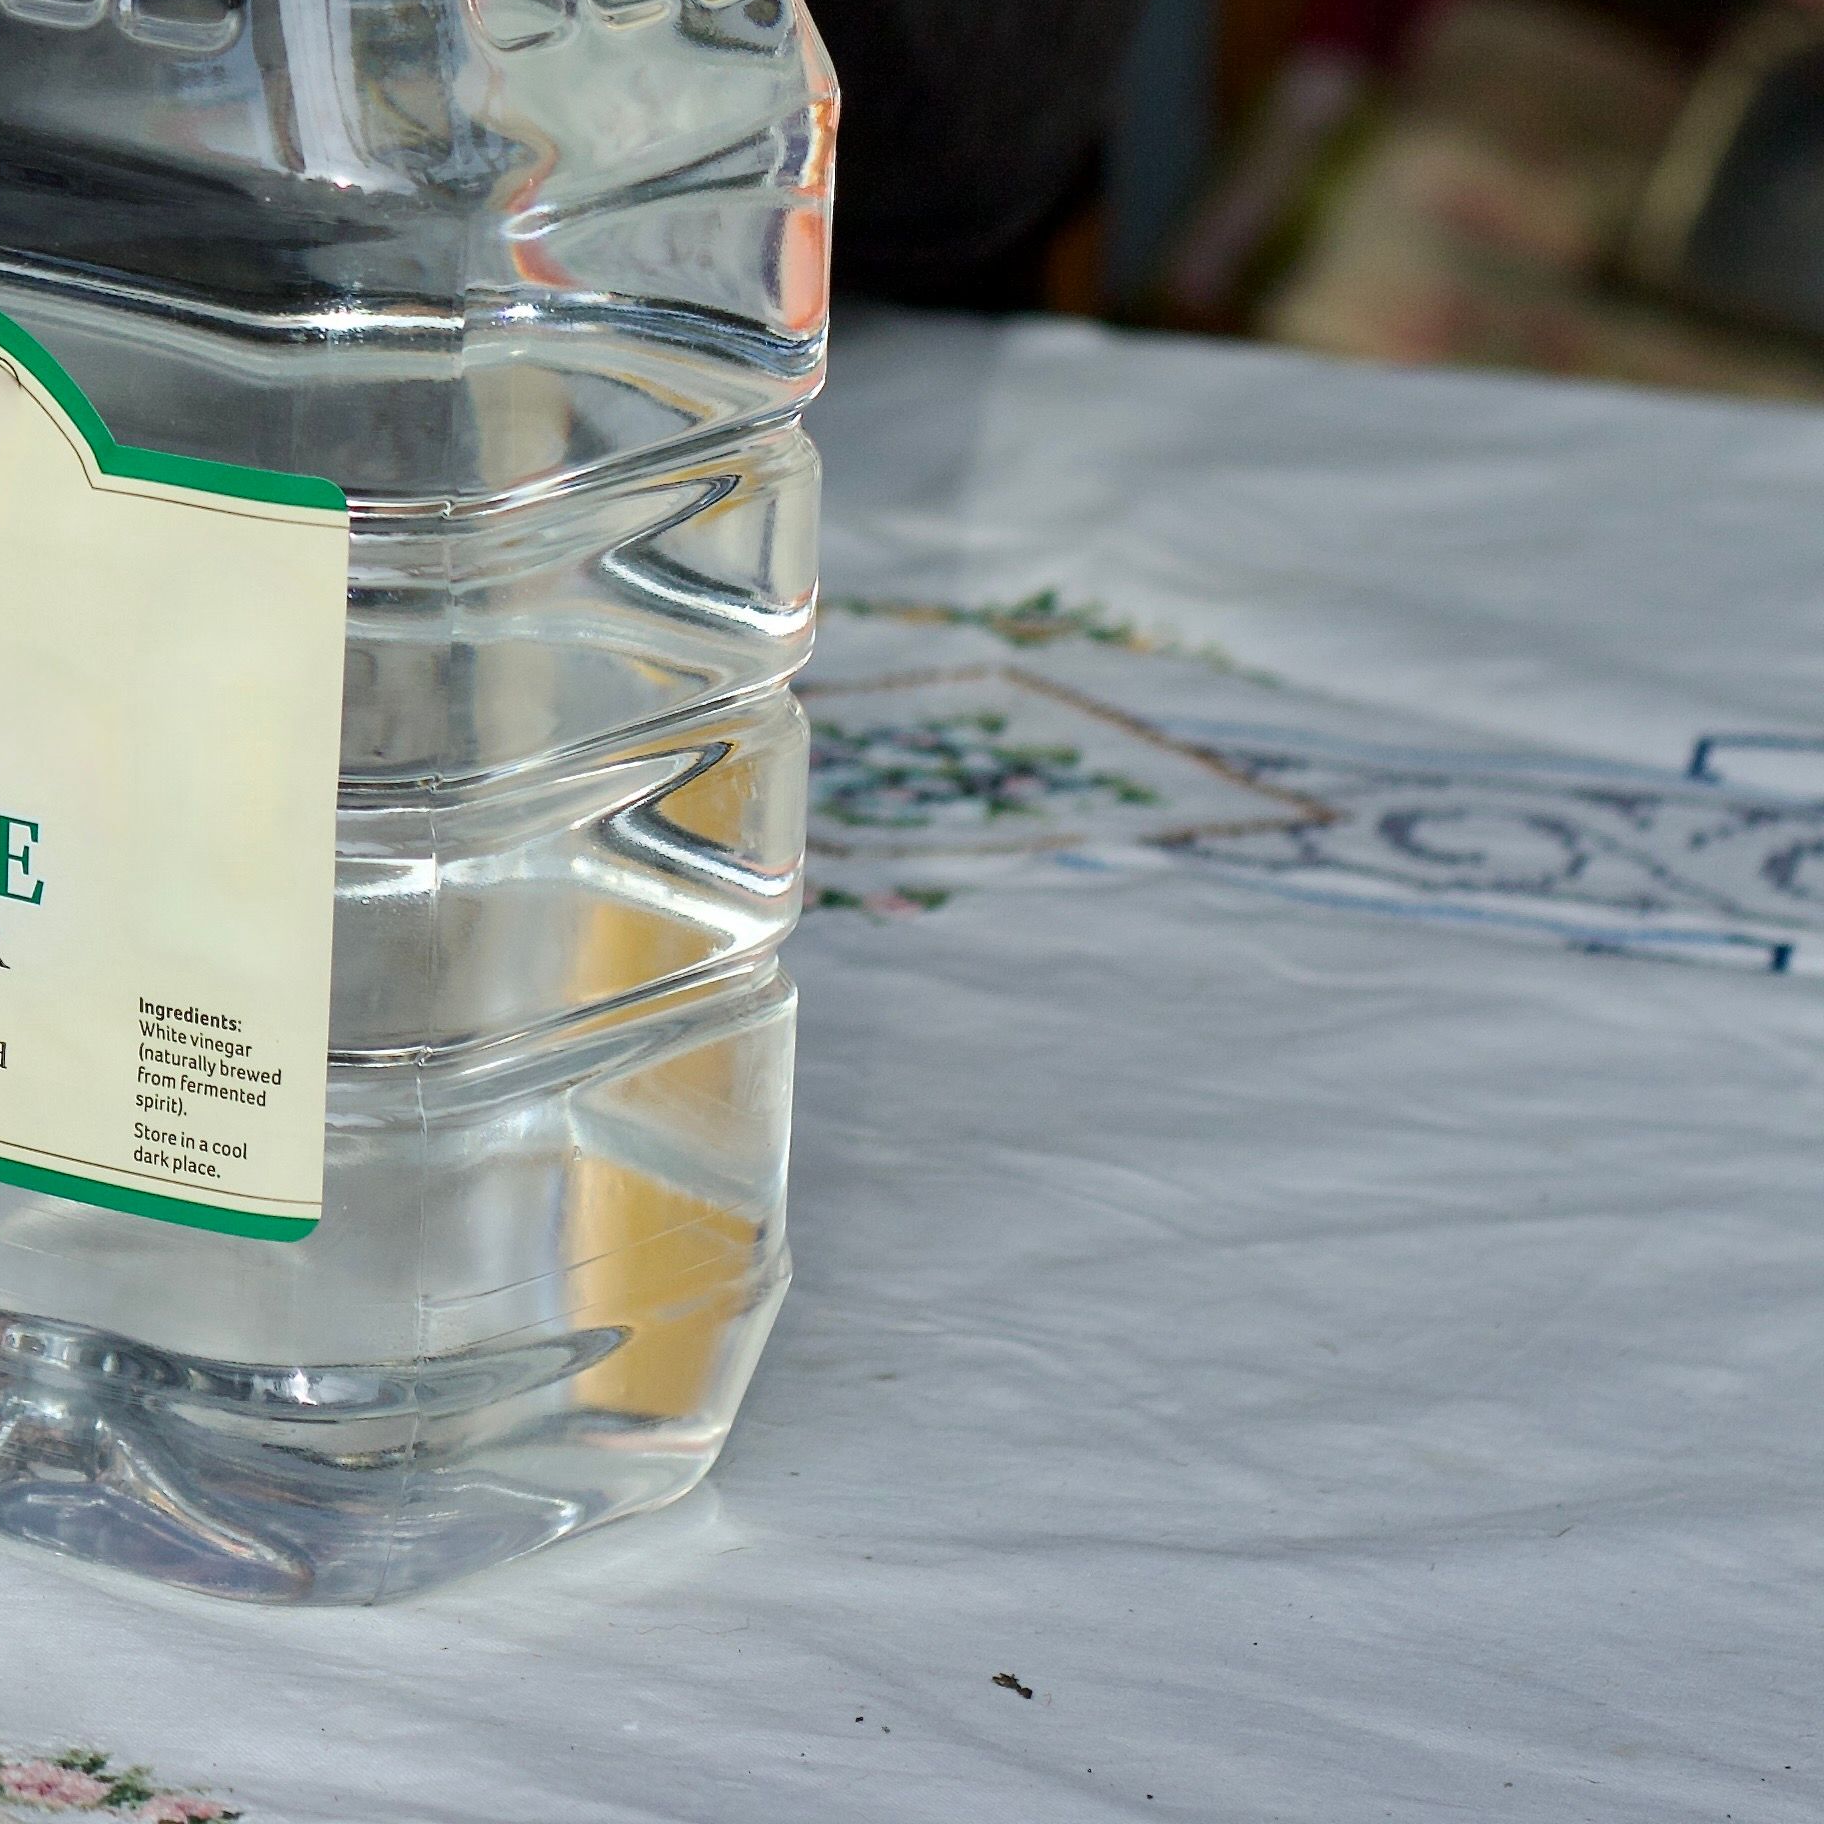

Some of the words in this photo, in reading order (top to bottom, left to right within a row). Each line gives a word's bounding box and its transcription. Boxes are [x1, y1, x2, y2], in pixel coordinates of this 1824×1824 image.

[139, 996, 242, 1033] Ingredients:
[139, 1020, 187, 1044] White
[190, 1032, 253, 1058] vinegar
[138, 1042, 216, 1077] (naturally
[220, 1059, 282, 1085] brewed
[136, 1093, 187, 1117] spirit).
[137, 1066, 176, 1089] from
[180, 1074, 266, 1107] fermented
[134, 1122, 177, 1146] Store
[181, 1131, 195, 1150] in
[199, 1140, 208, 1153] a
[212, 1142, 248, 1159] cool
[133, 1145, 169, 1168] dark
[173, 1155, 221, 1179] place.
